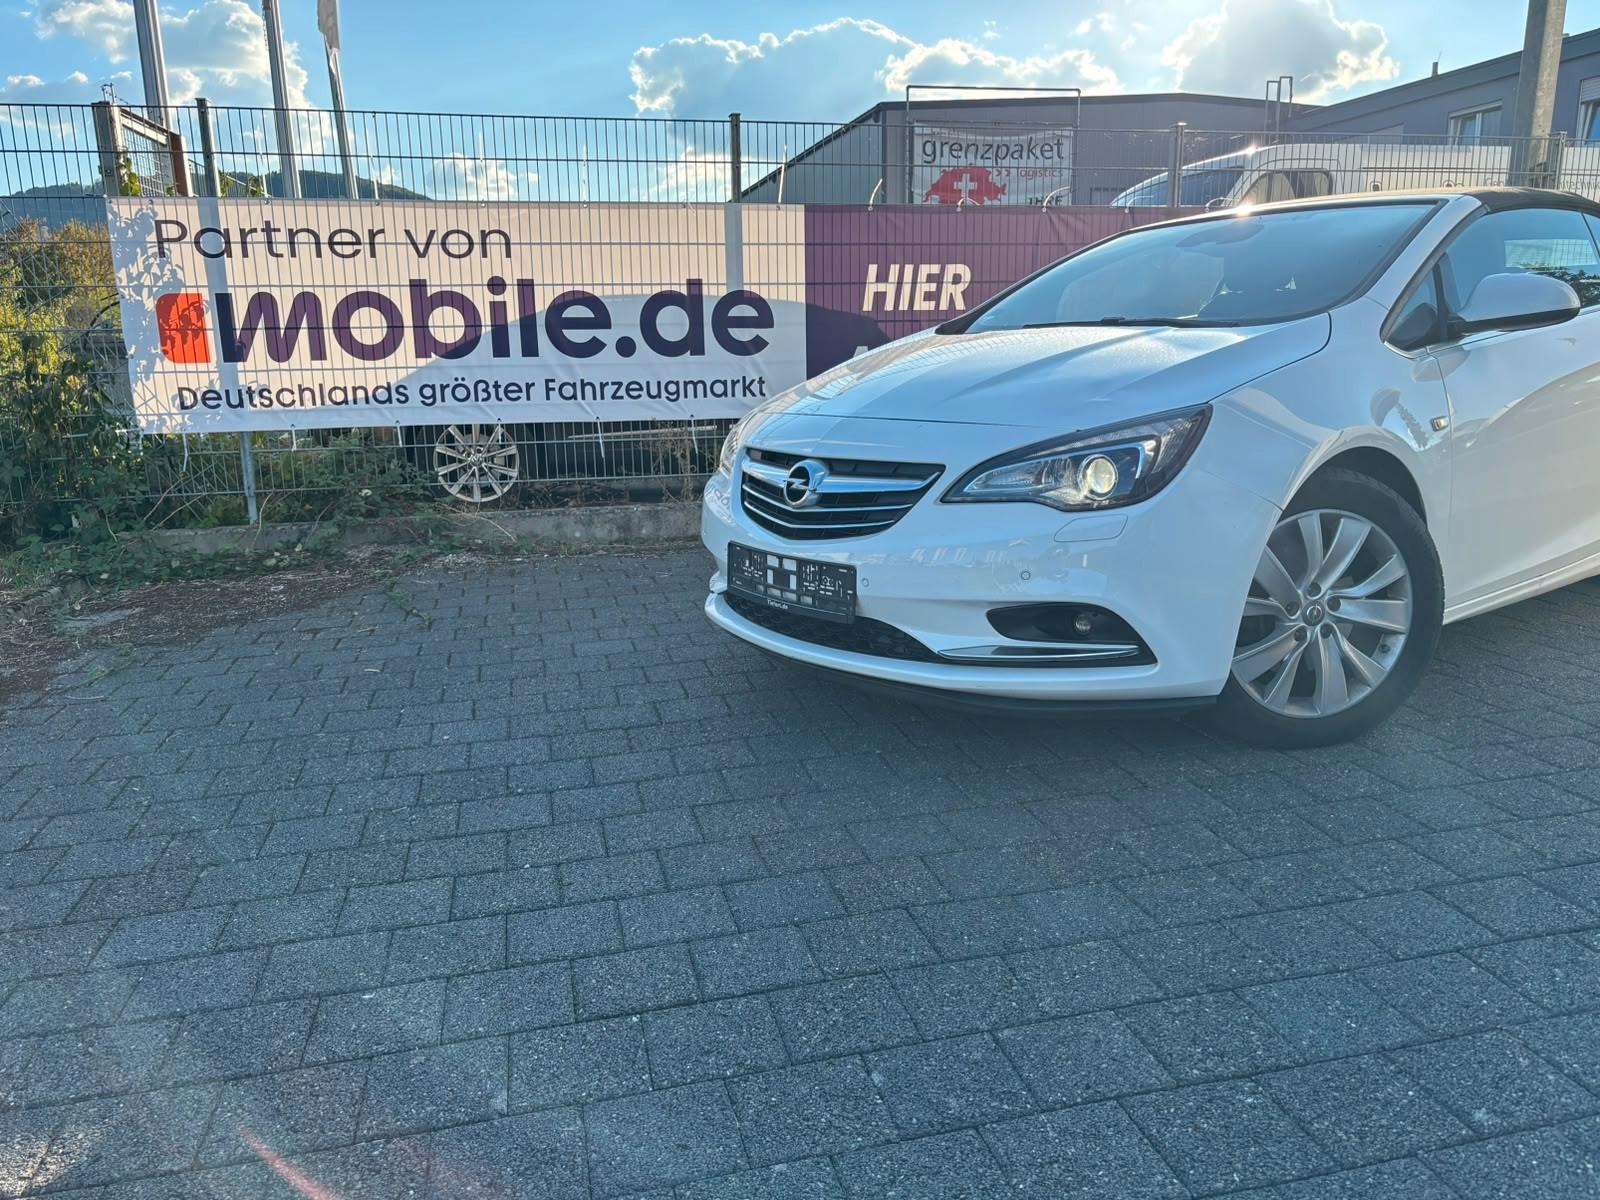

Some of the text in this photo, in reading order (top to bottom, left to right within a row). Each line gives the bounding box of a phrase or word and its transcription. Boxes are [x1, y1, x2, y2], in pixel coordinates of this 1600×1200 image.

[922, 136, 1065, 166] grenzpaket
[155, 219, 511, 259] Partner von
[862, 263, 971, 312] HIER
[215, 275, 775, 363] mobile.de
[177, 375, 766, 411] Deutschlands größter Fahrzeugmarkt
